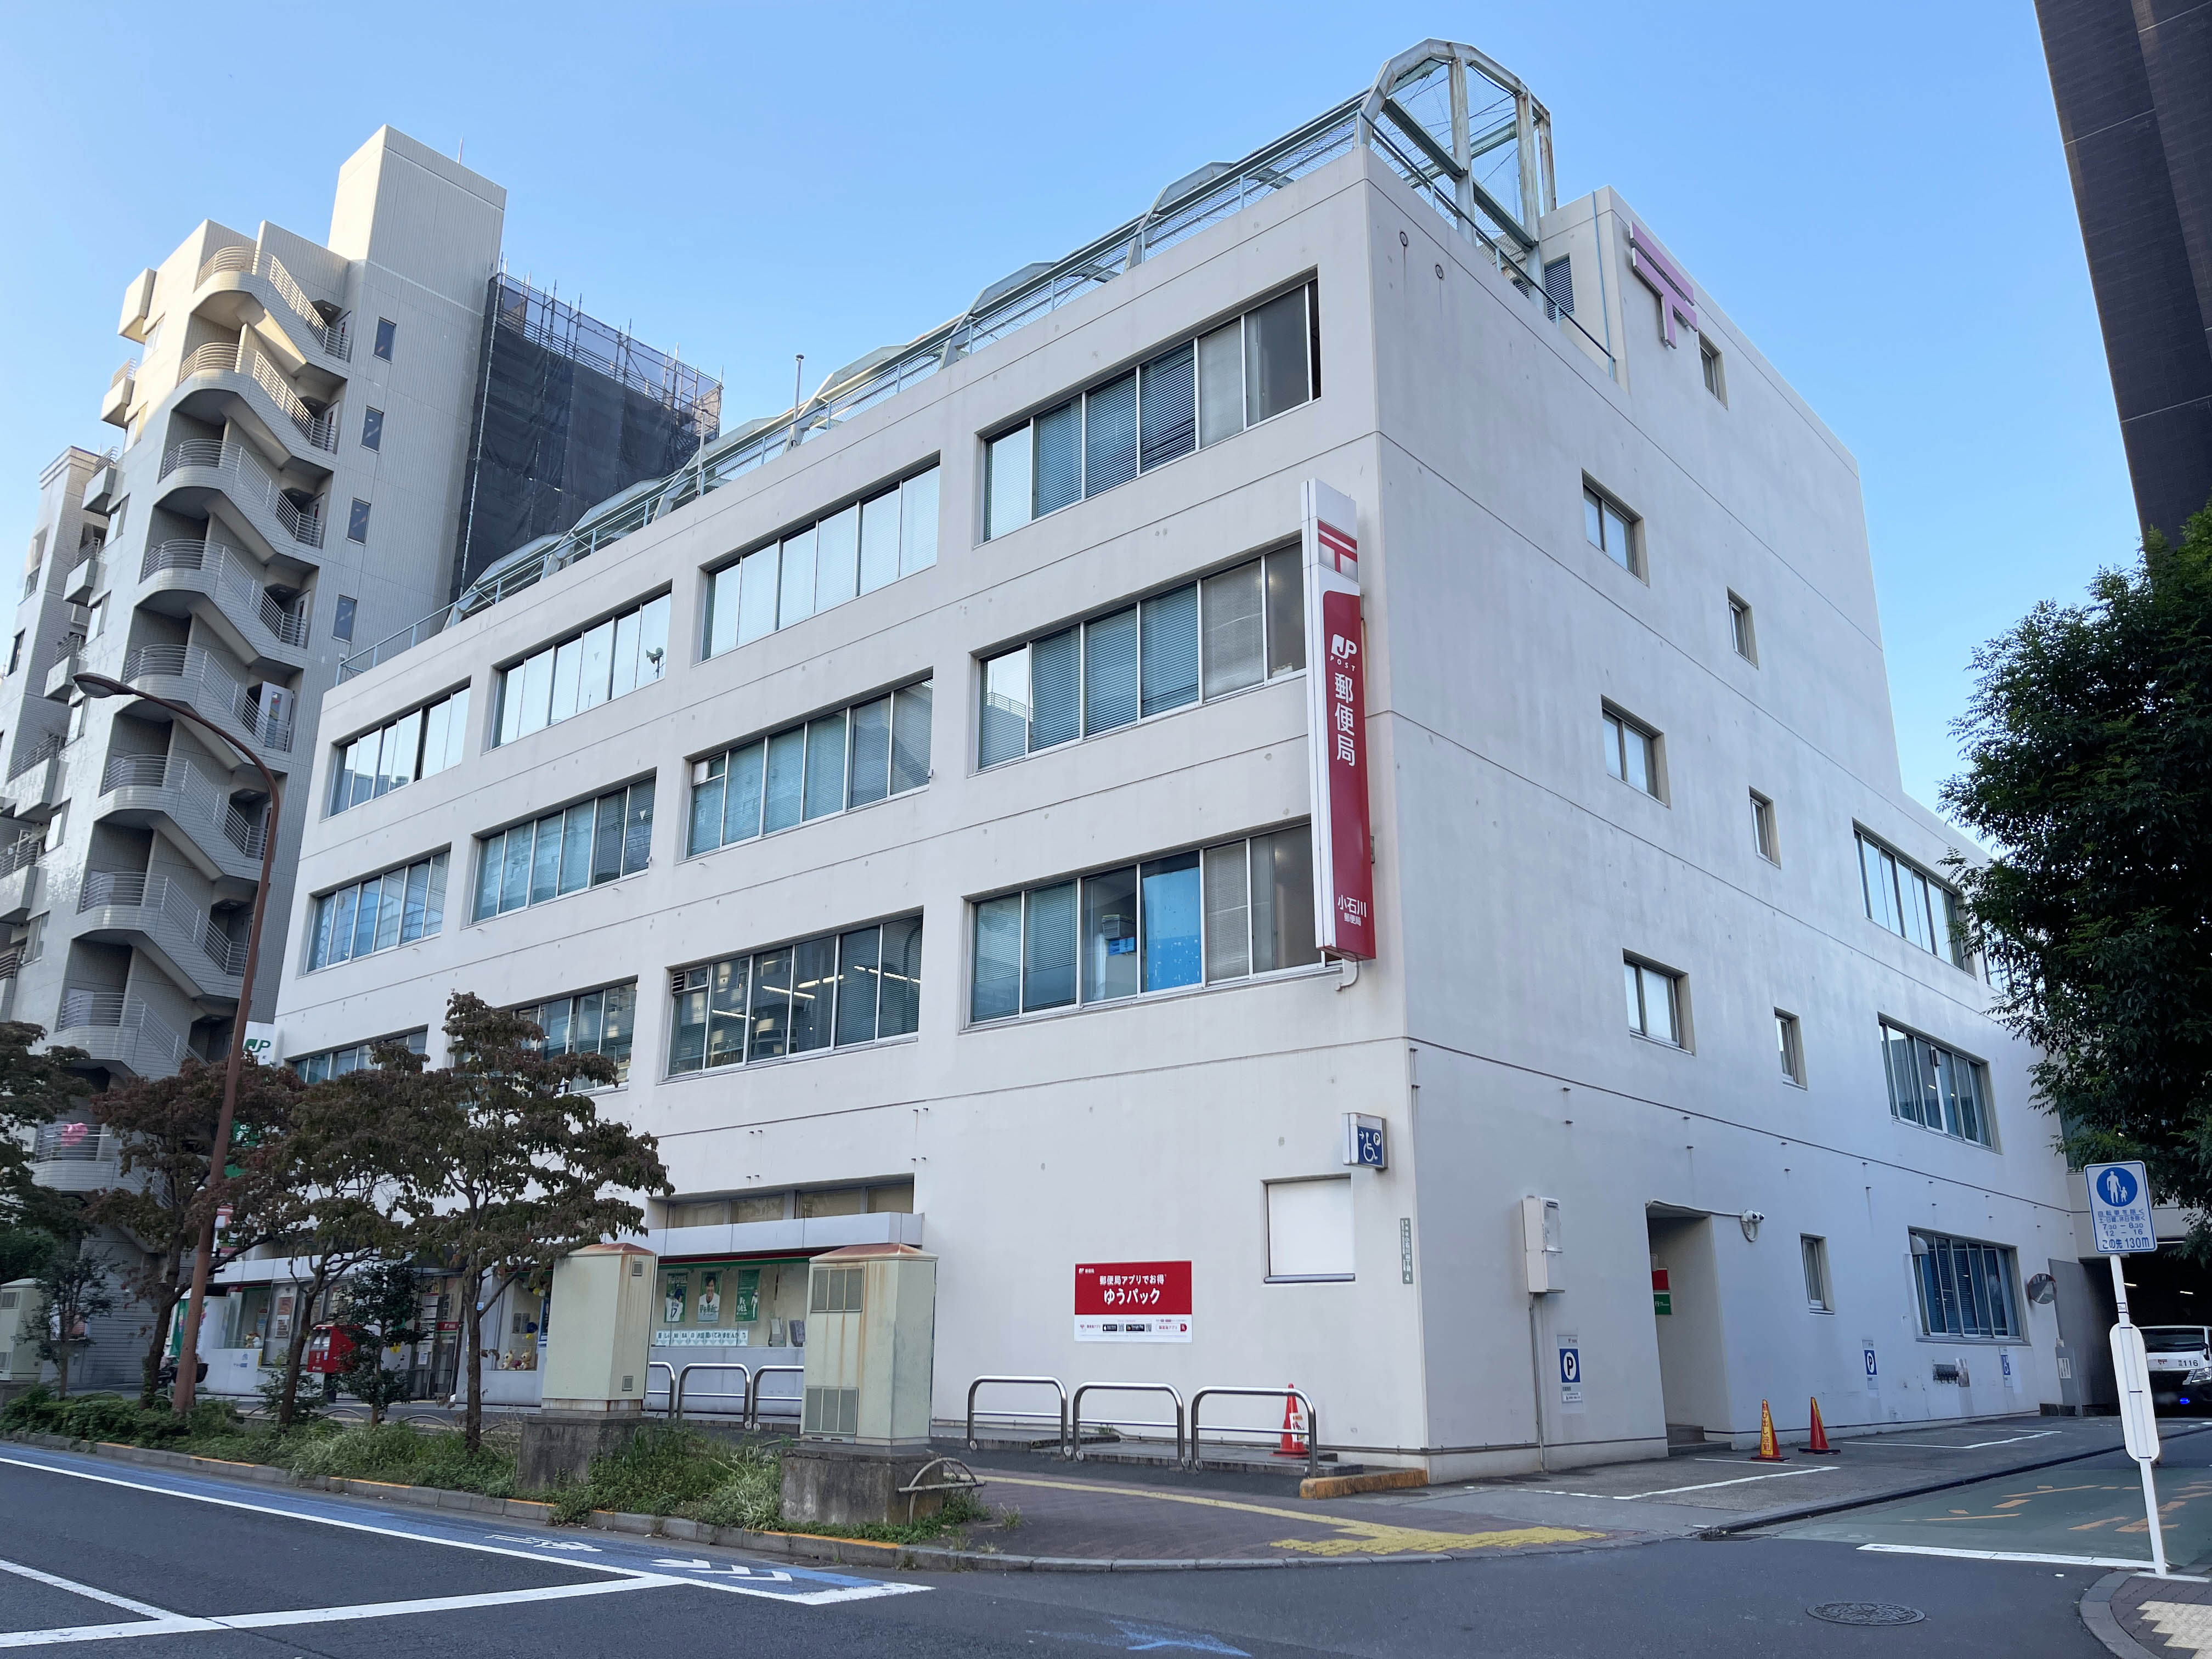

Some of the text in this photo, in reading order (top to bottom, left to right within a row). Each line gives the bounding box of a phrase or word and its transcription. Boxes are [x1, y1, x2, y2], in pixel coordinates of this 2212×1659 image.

[1330, 656, 1356, 672] POST
[1334, 672, 1356, 767] 郵便局
[1338, 894, 1367, 917] 小石川
[2102, 1237, 2149, 1249] この先 130m
[1104, 1288, 1160, 1305] ゆうパック
[1566, 1356, 1573, 1376] P
[1868, 1356, 1872, 1370] P
